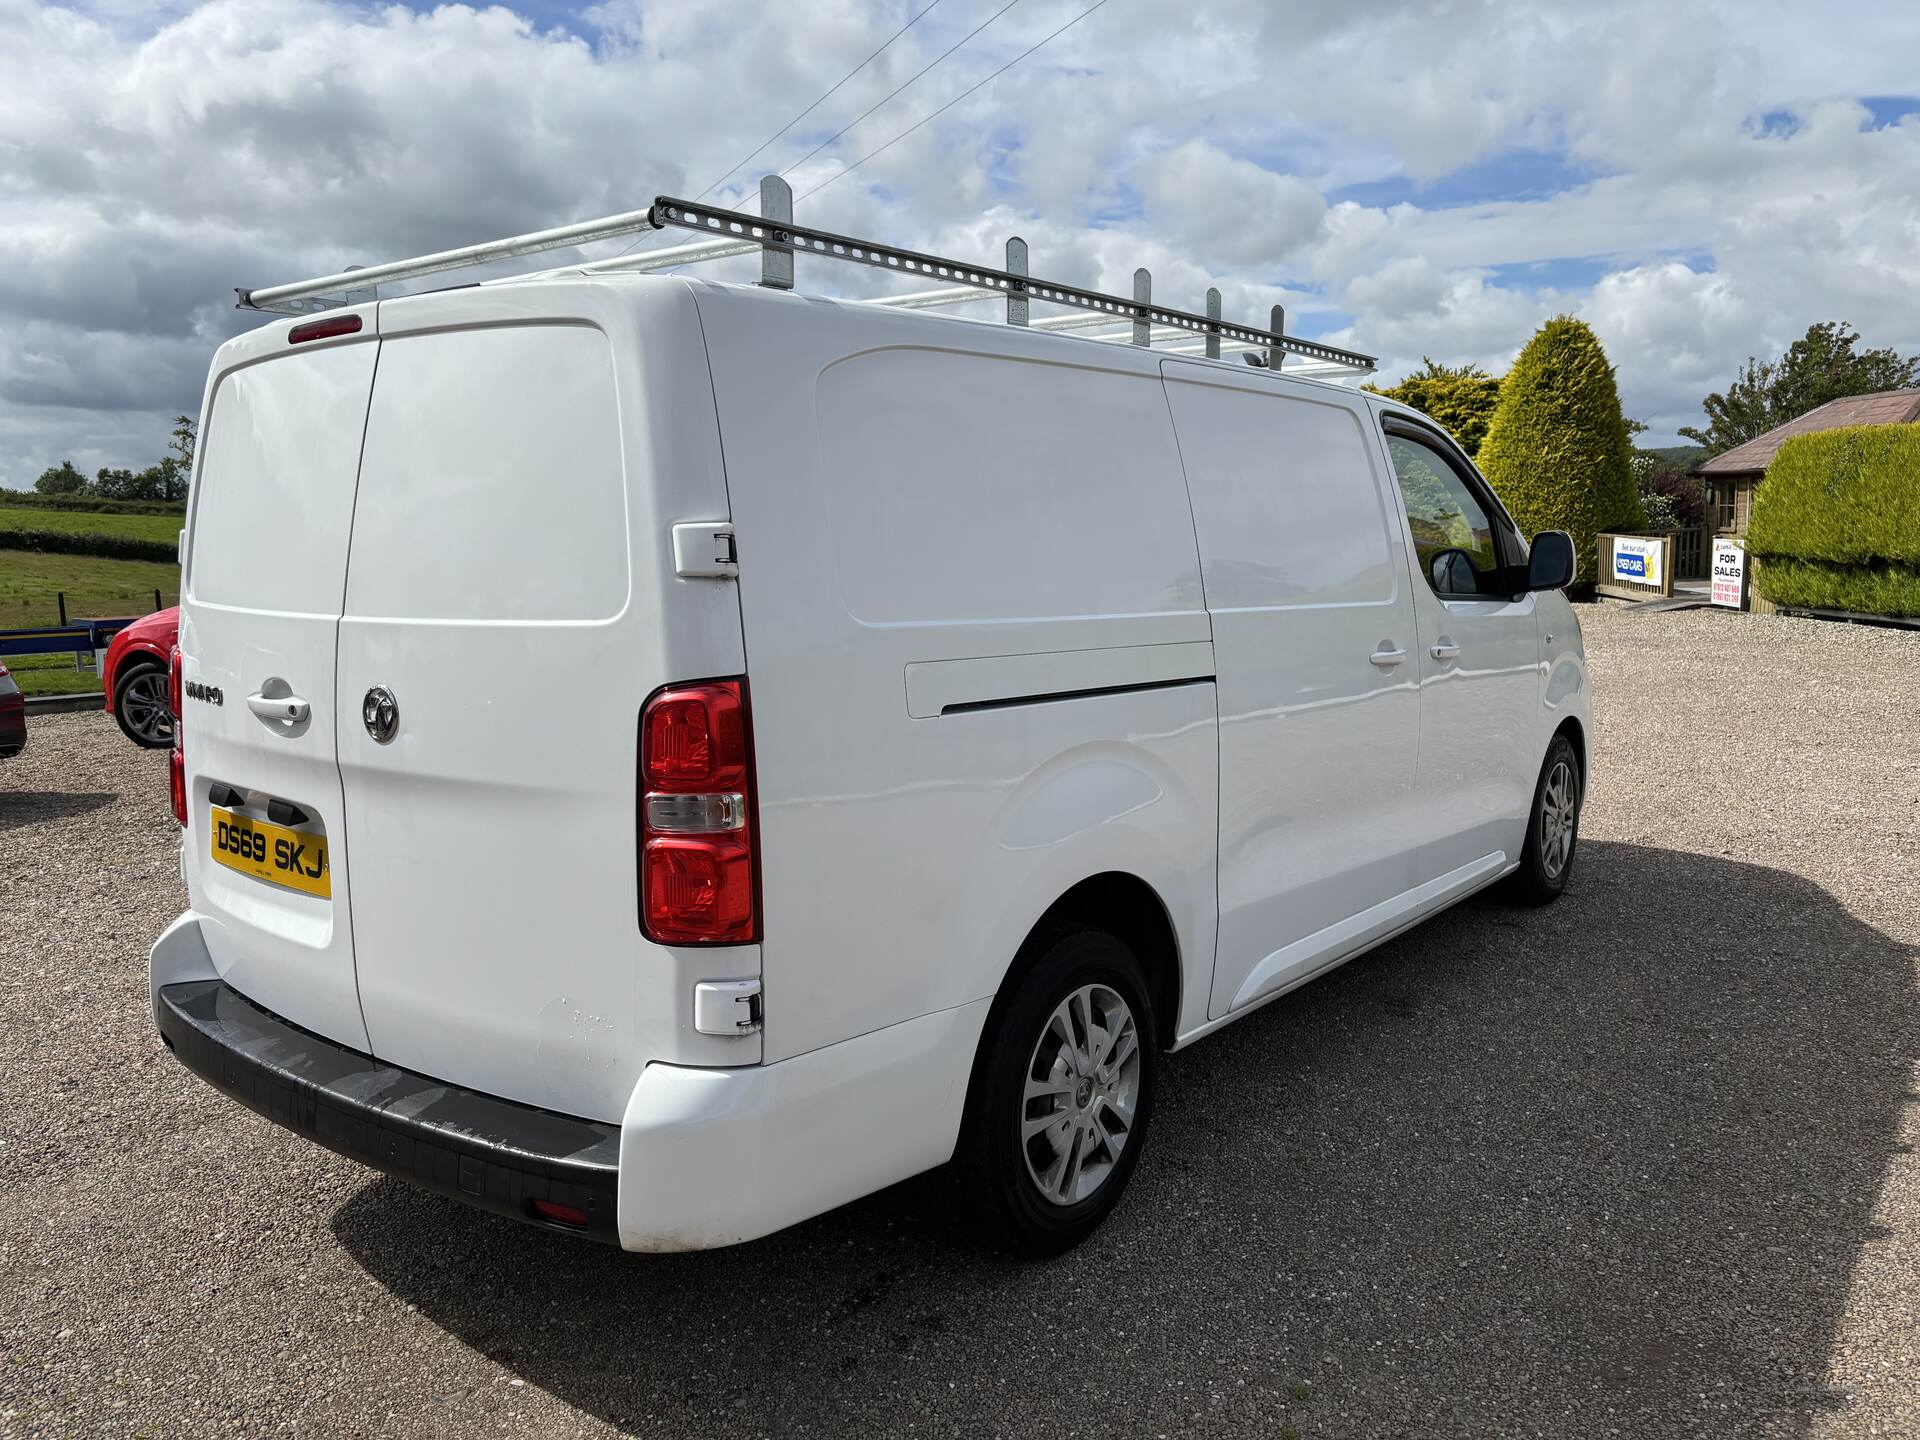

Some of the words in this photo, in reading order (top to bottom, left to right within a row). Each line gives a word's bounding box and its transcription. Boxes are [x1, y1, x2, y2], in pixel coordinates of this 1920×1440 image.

[1719, 554, 1736, 564] FOR
[1714, 566, 1741, 577] SALES
[218, 821, 265, 862] DS69
[274, 838, 323, 879] SKJ
